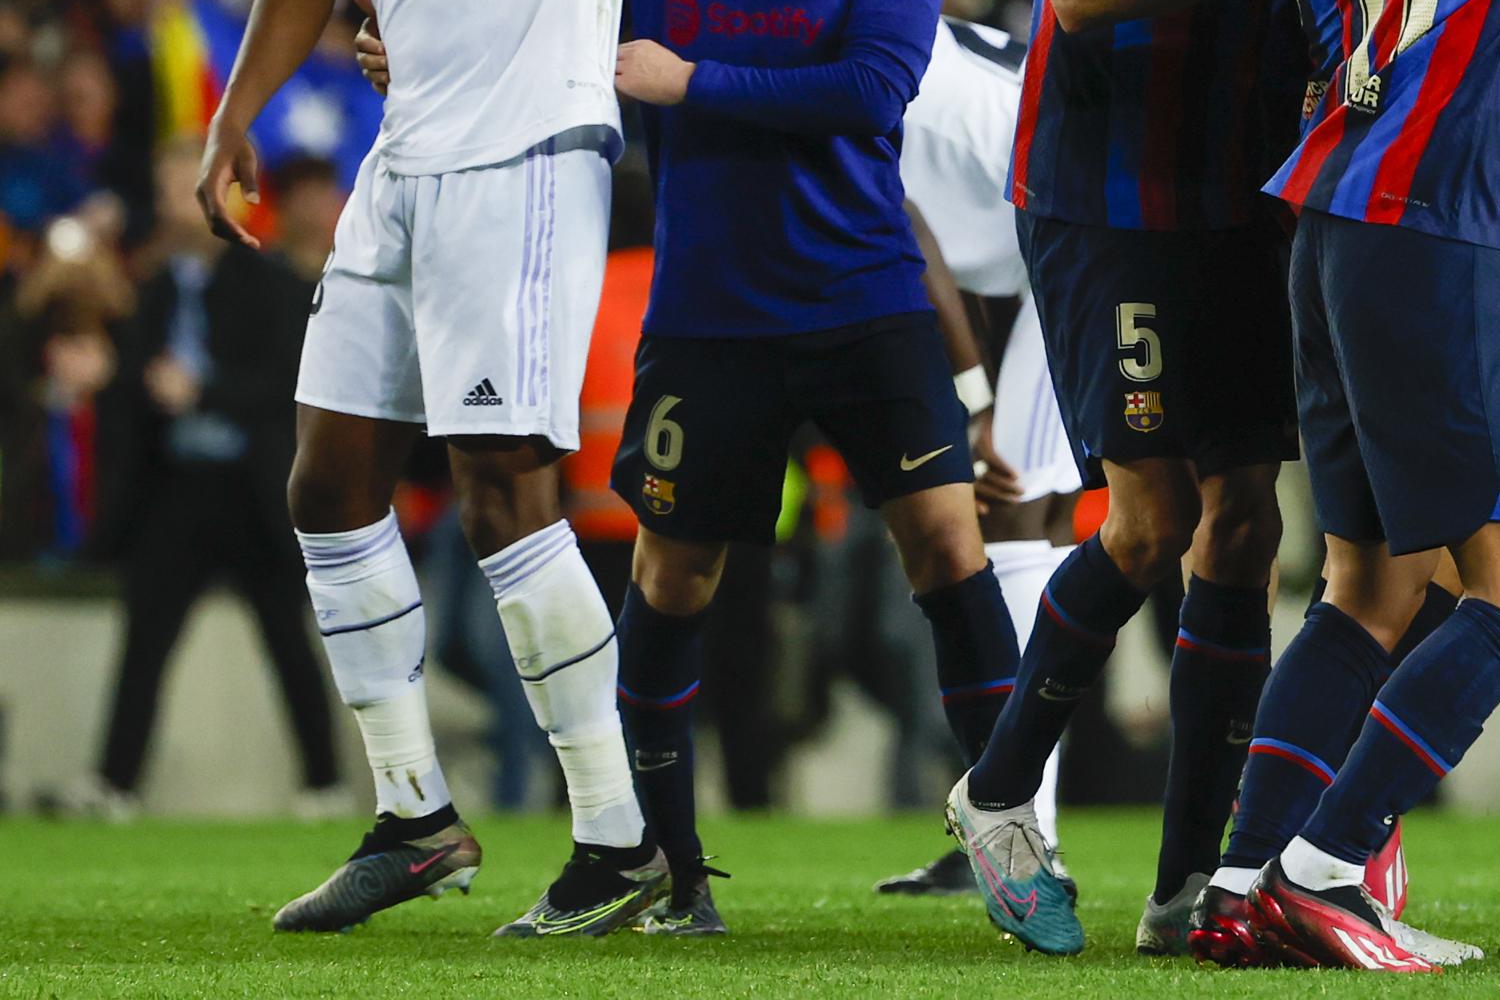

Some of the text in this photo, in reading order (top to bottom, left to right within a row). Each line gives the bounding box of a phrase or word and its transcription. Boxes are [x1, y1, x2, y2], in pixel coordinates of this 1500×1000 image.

[707, 2, 825, 46] Spotify
[1115, 303, 1163, 382] 5
[462, 394, 503, 406] adidas
[644, 395, 683, 471] 6
